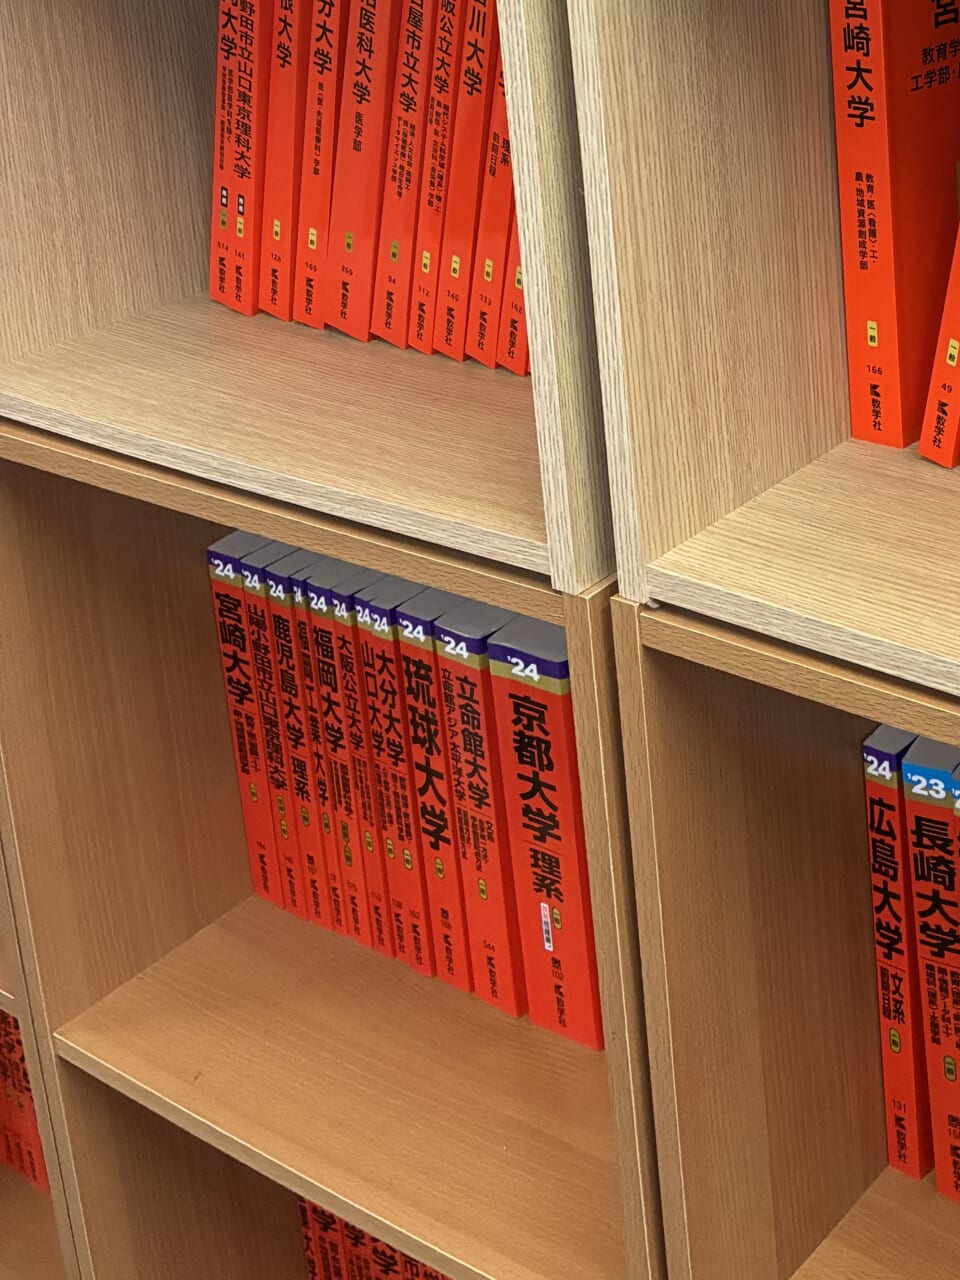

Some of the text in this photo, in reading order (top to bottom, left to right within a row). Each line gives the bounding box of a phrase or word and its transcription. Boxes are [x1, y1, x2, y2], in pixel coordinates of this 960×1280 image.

[866, 365, 883, 375] 166
[214, 591, 254, 706] 宮崎大学
[272, 613, 305, 750] 鹿児島大学
[313, 625, 346, 754] 福岡大学
[376, 649, 406, 768] 大分大学
[402, 654, 451, 851] 琉球大学
[456, 675, 491, 809] 立命館大学
[508, 693, 565, 903] 京都大学 理系
[866, 797, 904, 960] 広島大学
